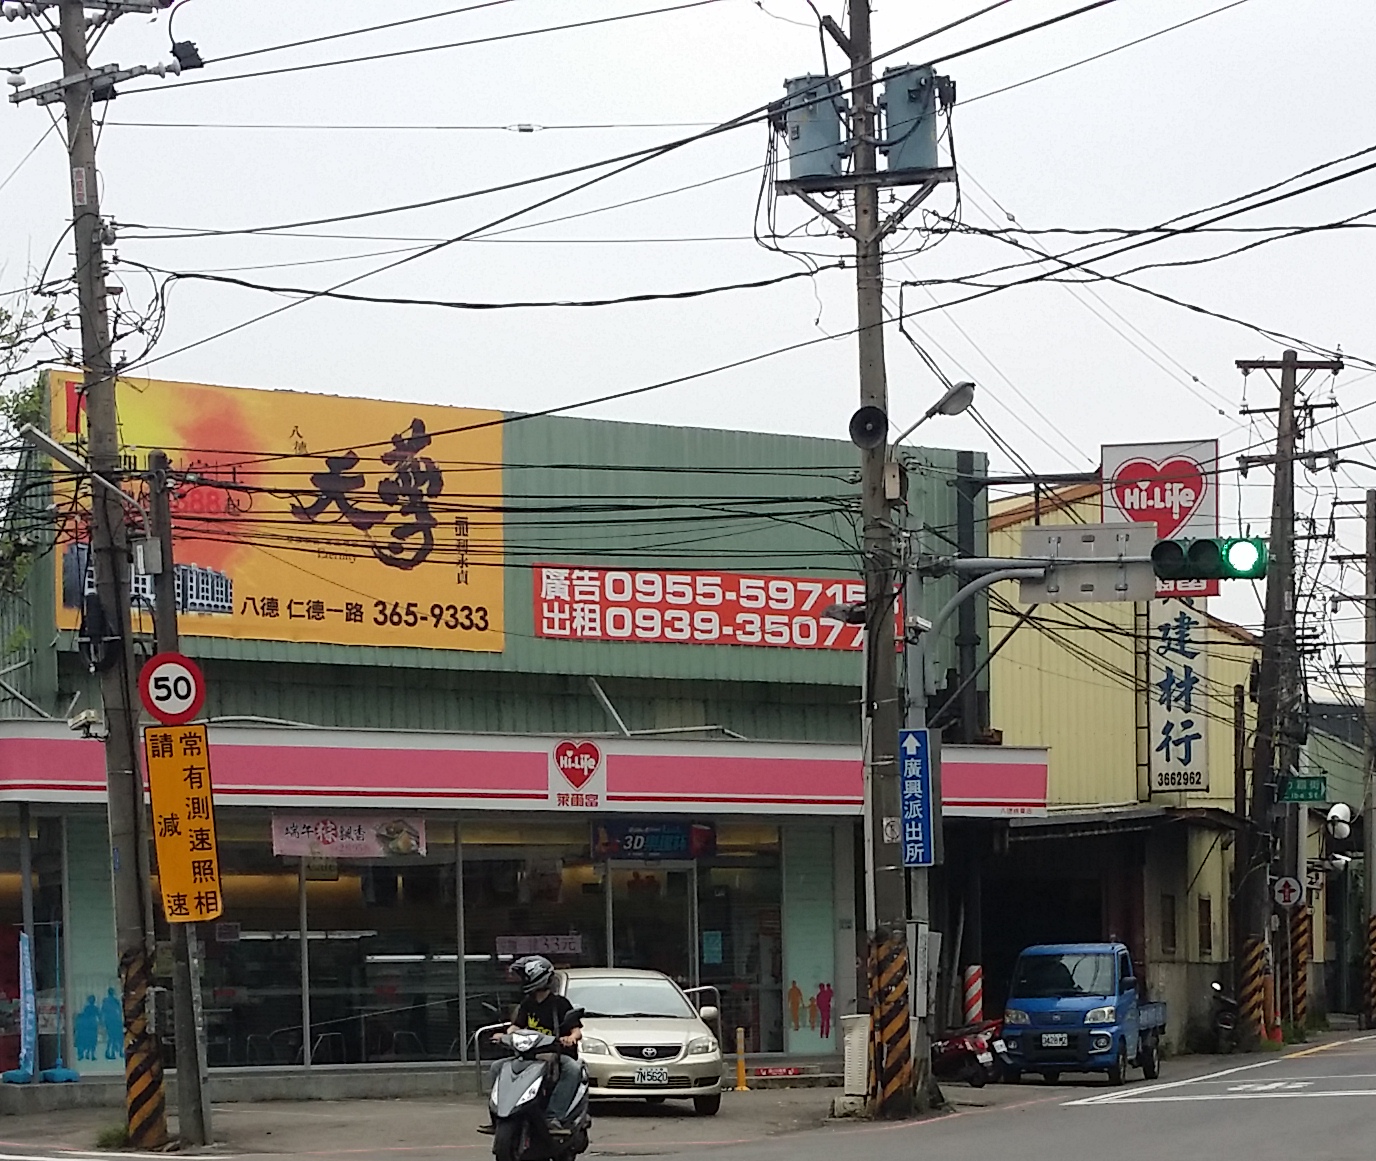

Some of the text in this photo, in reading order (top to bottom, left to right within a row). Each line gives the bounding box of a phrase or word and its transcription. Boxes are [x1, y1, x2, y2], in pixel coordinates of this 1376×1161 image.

[241, 596, 489, 631] 八德 仁德一路 365-9333
[153, 676, 192, 701] 50
[1156, 597, 1202, 767] 建材行
[149, 734, 190, 917] 請減速
[179, 731, 219, 915] 常有測速照相
[903, 758, 924, 862] 廣興派出所
[1157, 772, 1201, 786] 3662962
